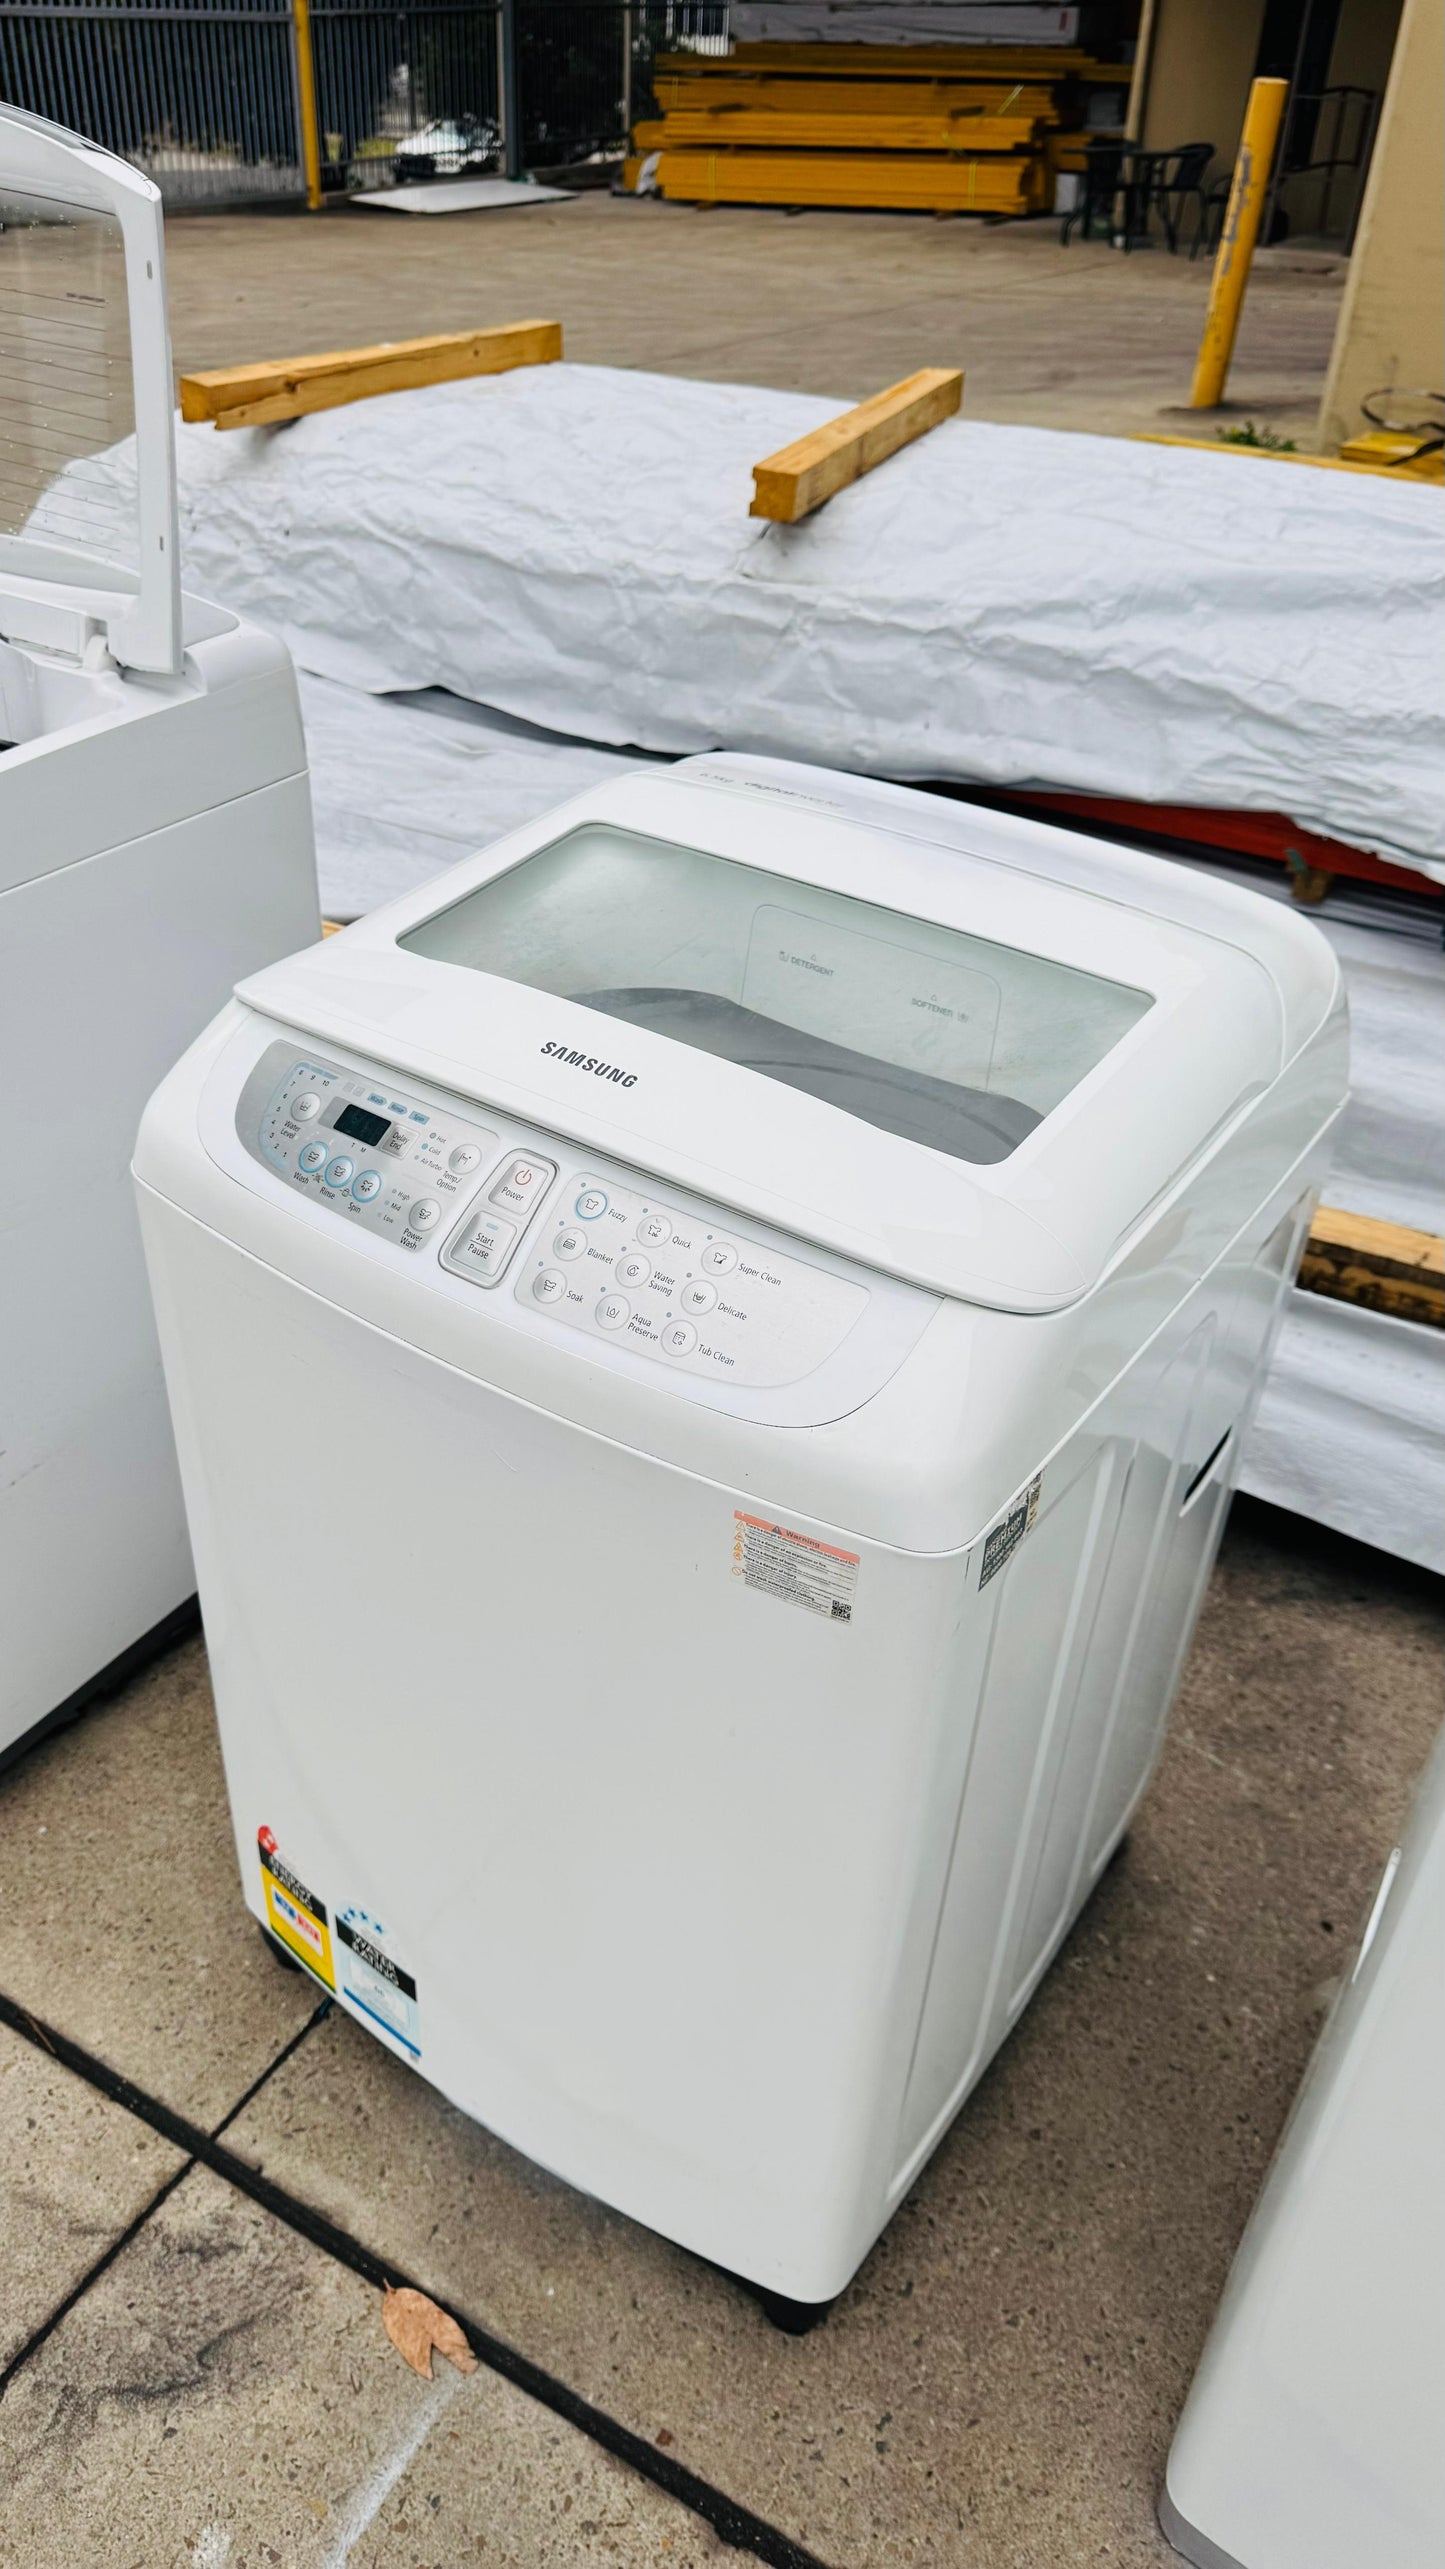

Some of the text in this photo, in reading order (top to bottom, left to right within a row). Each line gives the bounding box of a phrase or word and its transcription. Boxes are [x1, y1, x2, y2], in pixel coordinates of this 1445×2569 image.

[791, 956, 835, 977] DETERGENT
[911, 997, 953, 1018] SOFTENER
[540, 1041, 639, 1088] SAMSUNG
[284, 1120, 302, 1132] Water
[280, 1128, 297, 1140] Level
[392, 1131, 410, 1144] Delay
[436, 1136, 447, 1144] Hot
[389, 1140, 402, 1151] End
[428, 1146, 441, 1156] Cold
[293, 1171, 310, 1185] Wash
[442, 1170, 462, 1184] Temp/
[319, 1186, 336, 1200] Rinse
[436, 1179, 457, 1194] Option
[501, 1186, 524, 1202] Power
[398, 1191, 410, 1201] High
[347, 1201, 361, 1213] Spin
[390, 1202, 401, 1211] Mid
[608, 1208, 628, 1223] Fuzzy
[403, 1227, 423, 1242] Power
[476, 1232, 495, 1247] Start
[400, 1236, 417, 1250] Wash
[671, 1235, 693, 1250] Quick
[467, 1243, 489, 1260] Pause
[587, 1247, 614, 1265] Blanket
[653, 1270, 676, 1286] Water
[738, 1262, 782, 1287] Super Clean
[566, 1289, 584, 1304] Soak
[648, 1281, 673, 1297] Saving
[717, 1302, 748, 1321] Delicate
[632, 1313, 652, 1328] Aqua
[627, 1322, 659, 1342] Preserve
[699, 1344, 736, 1367] Tub Clean
[785, 1530, 820, 1547] Warning
